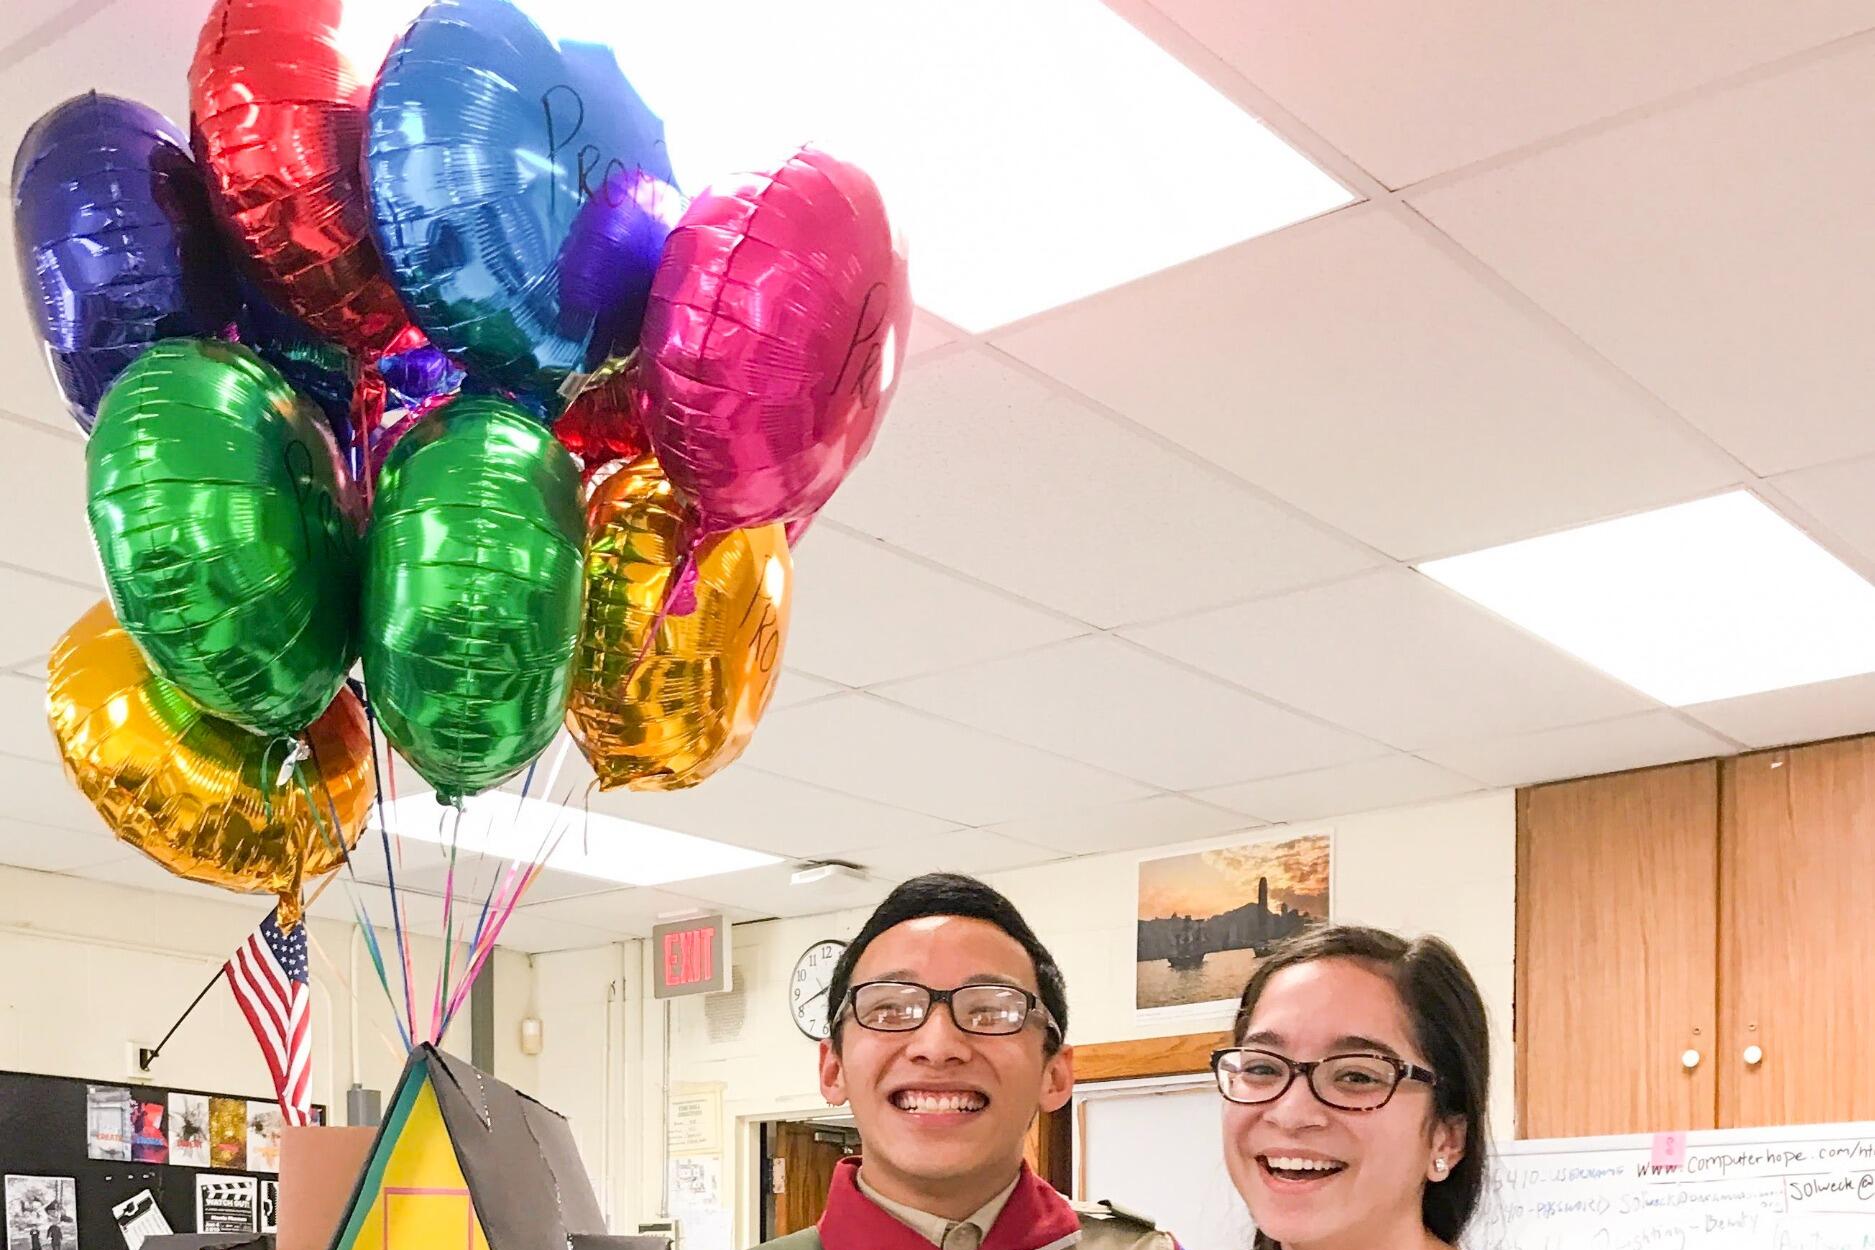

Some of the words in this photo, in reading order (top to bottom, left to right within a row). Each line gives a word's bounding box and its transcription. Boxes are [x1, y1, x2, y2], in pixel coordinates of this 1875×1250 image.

[663, 927, 717, 987] EXIT
[821, 946, 833, 959] 12
[808, 954, 818, 967] 11
[797, 968, 807, 982] 10
[794, 988, 801, 1000] 9
[797, 1006, 805, 1019] 8
[809, 1019, 816, 1033] 7
[822, 1023, 830, 1035] 6
